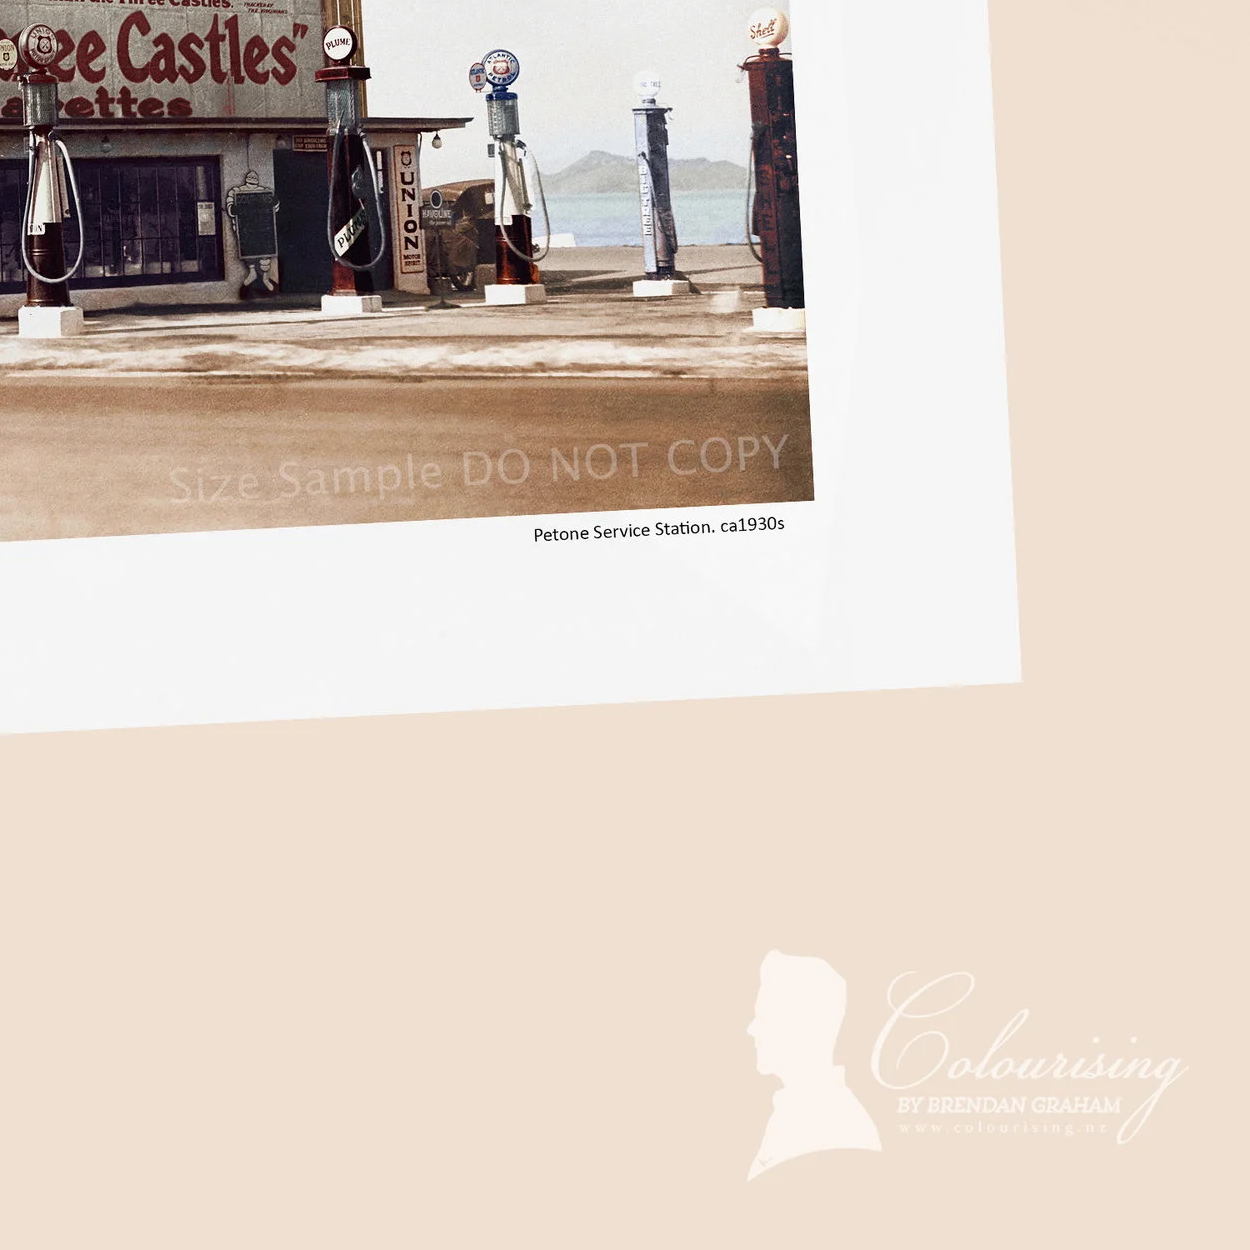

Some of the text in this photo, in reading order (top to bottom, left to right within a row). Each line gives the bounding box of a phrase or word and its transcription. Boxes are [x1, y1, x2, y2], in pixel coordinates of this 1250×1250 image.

[750, 18, 778, 40] Shell
[325, 37, 351, 51] PLUME
[487, 53, 516, 65] ATLANTIC
[400, 172, 419, 250] UNION
[533, 516, 786, 543] Petone Service Station. ca1930s
